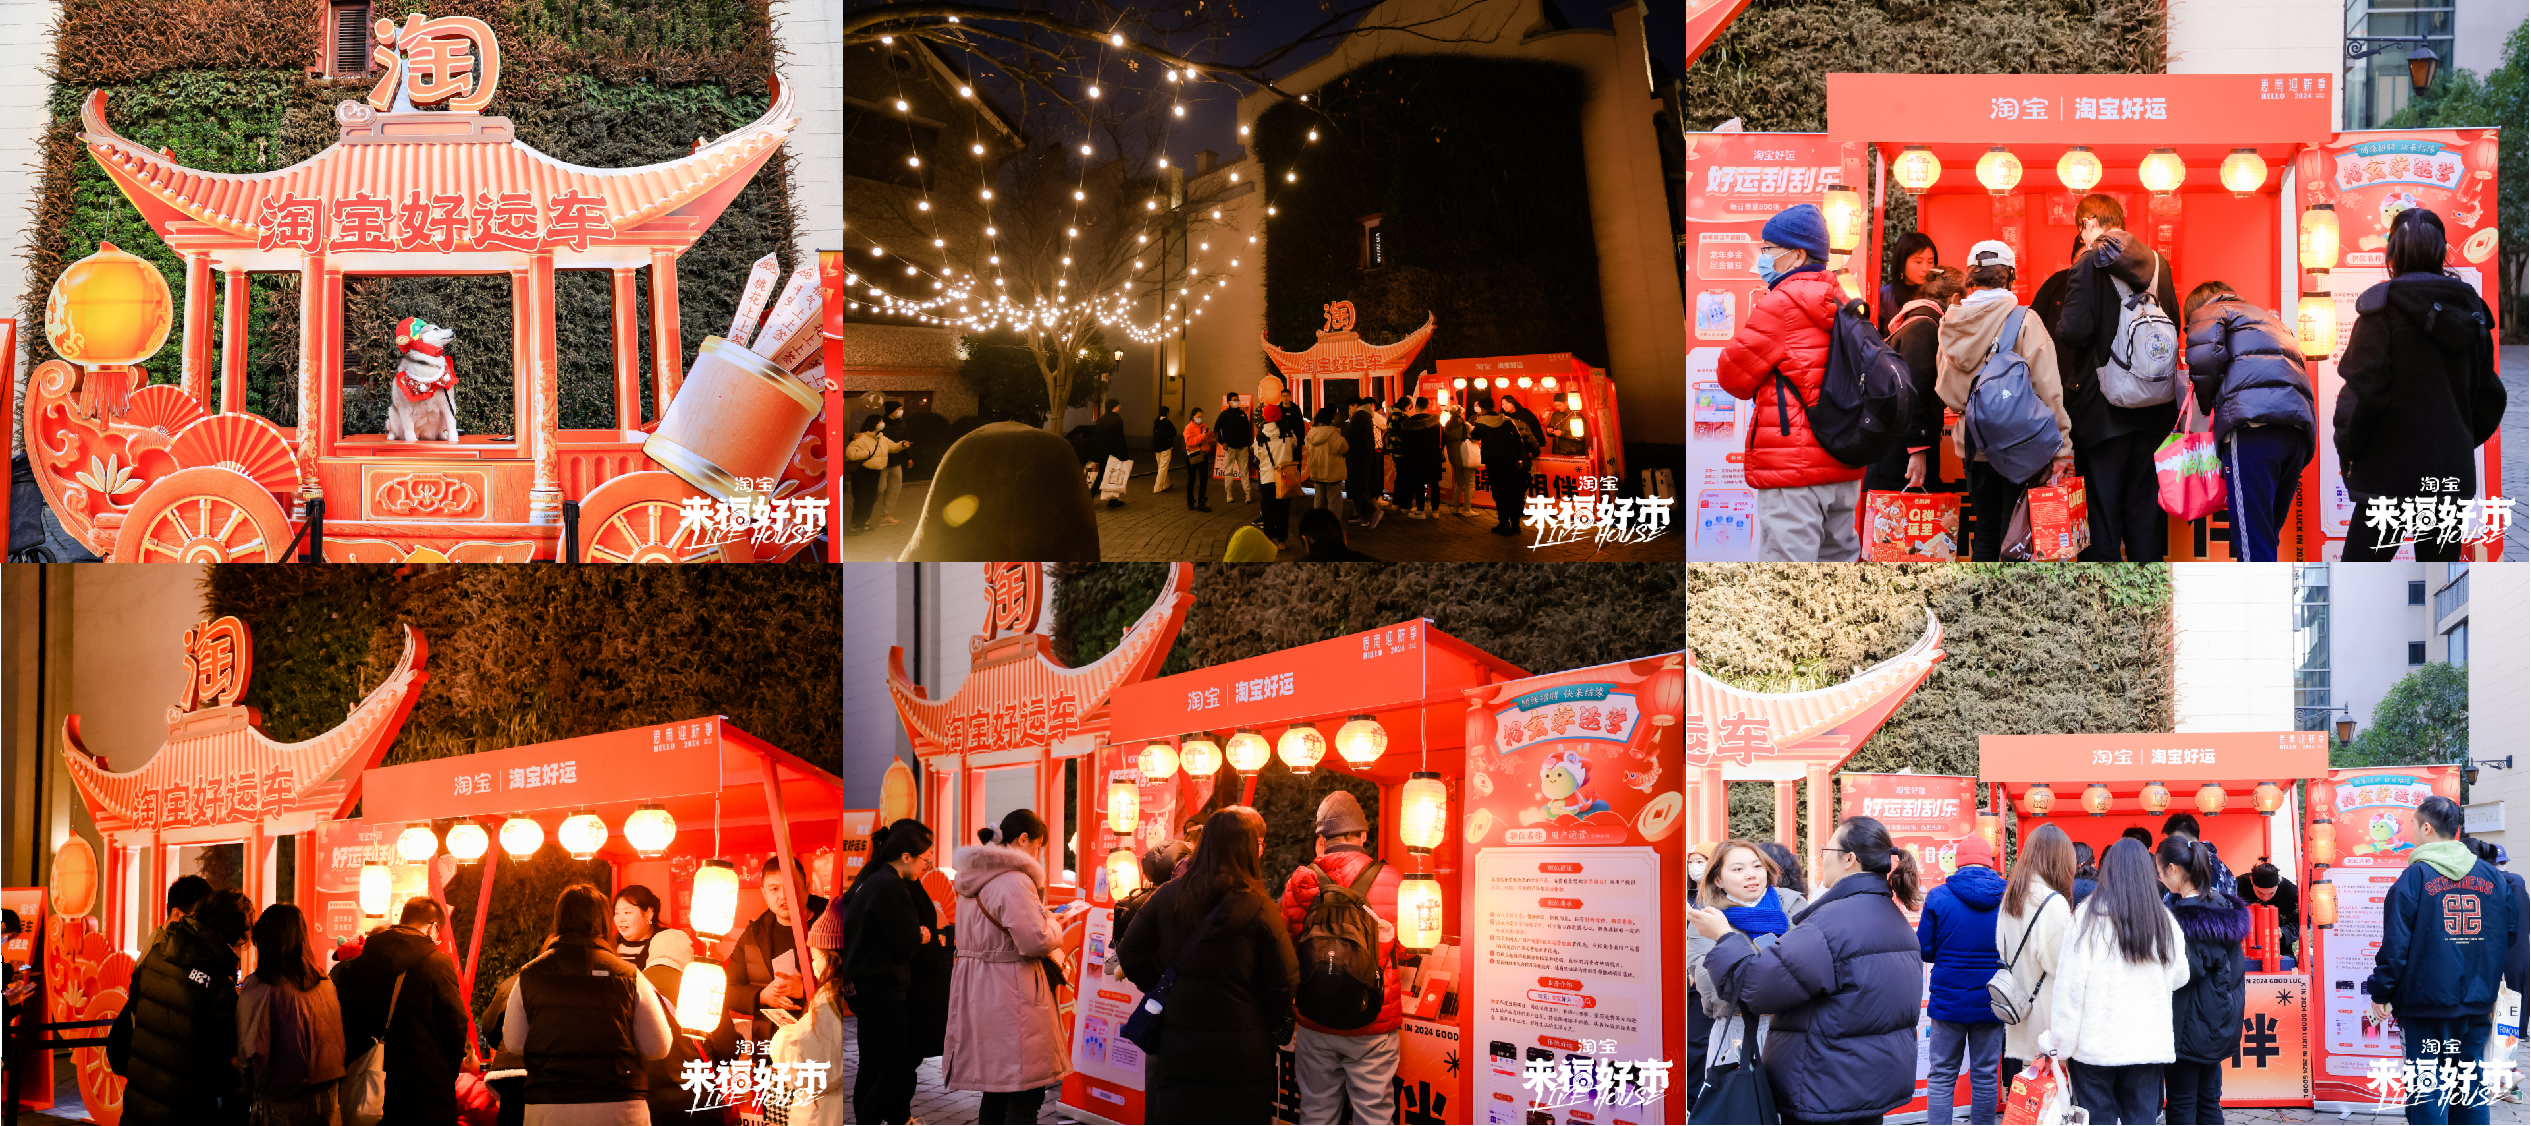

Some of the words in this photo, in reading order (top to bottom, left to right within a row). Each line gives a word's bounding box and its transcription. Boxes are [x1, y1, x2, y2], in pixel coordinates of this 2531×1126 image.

[368, 13, 500, 111] 淘
[1990, 97, 2048, 120] 淘宝
[2075, 97, 2167, 120] 淘宝好运
[1753, 150, 1796, 161] 淘宝好运
[1706, 166, 1843, 196] 好运刮刮乐
[257, 189, 616, 253] 淘宝好运车
[1324, 301, 1356, 332] 淘
[1301, 353, 1384, 374] 淘宝好运车
[2295, 509, 2303, 537] LUCK
[982, 562, 1039, 641] 淘
[180, 616, 250, 712] 淘
[1187, 687, 1220, 712] 淘宝
[1235, 672, 1294, 703] 淘宝好运
[944, 689, 1079, 756] 淘宝好运车
[684, 740, 700, 748] 2024
[2092, 749, 2133, 765] 淘宝
[2151, 748, 2216, 764] 淘宝好运
[454, 773, 492, 796] 淘宝
[509, 761, 577, 790] 淘宝好运
[1895, 786, 1926, 795] 淘宝好运
[132, 764, 298, 832] 淘宝好运车
[1862, 797, 1959, 818] 好运刮刮乐
[1509, 831, 1543, 840] 职位名称
[1551, 829, 1587, 840] 用户运营
[2424, 876, 2494, 896] SKECHERS
[1404, 1023, 1413, 1032] IN
[1414, 1025, 1433, 1036] 2024
[1436, 1029, 1459, 1041] GOOD
